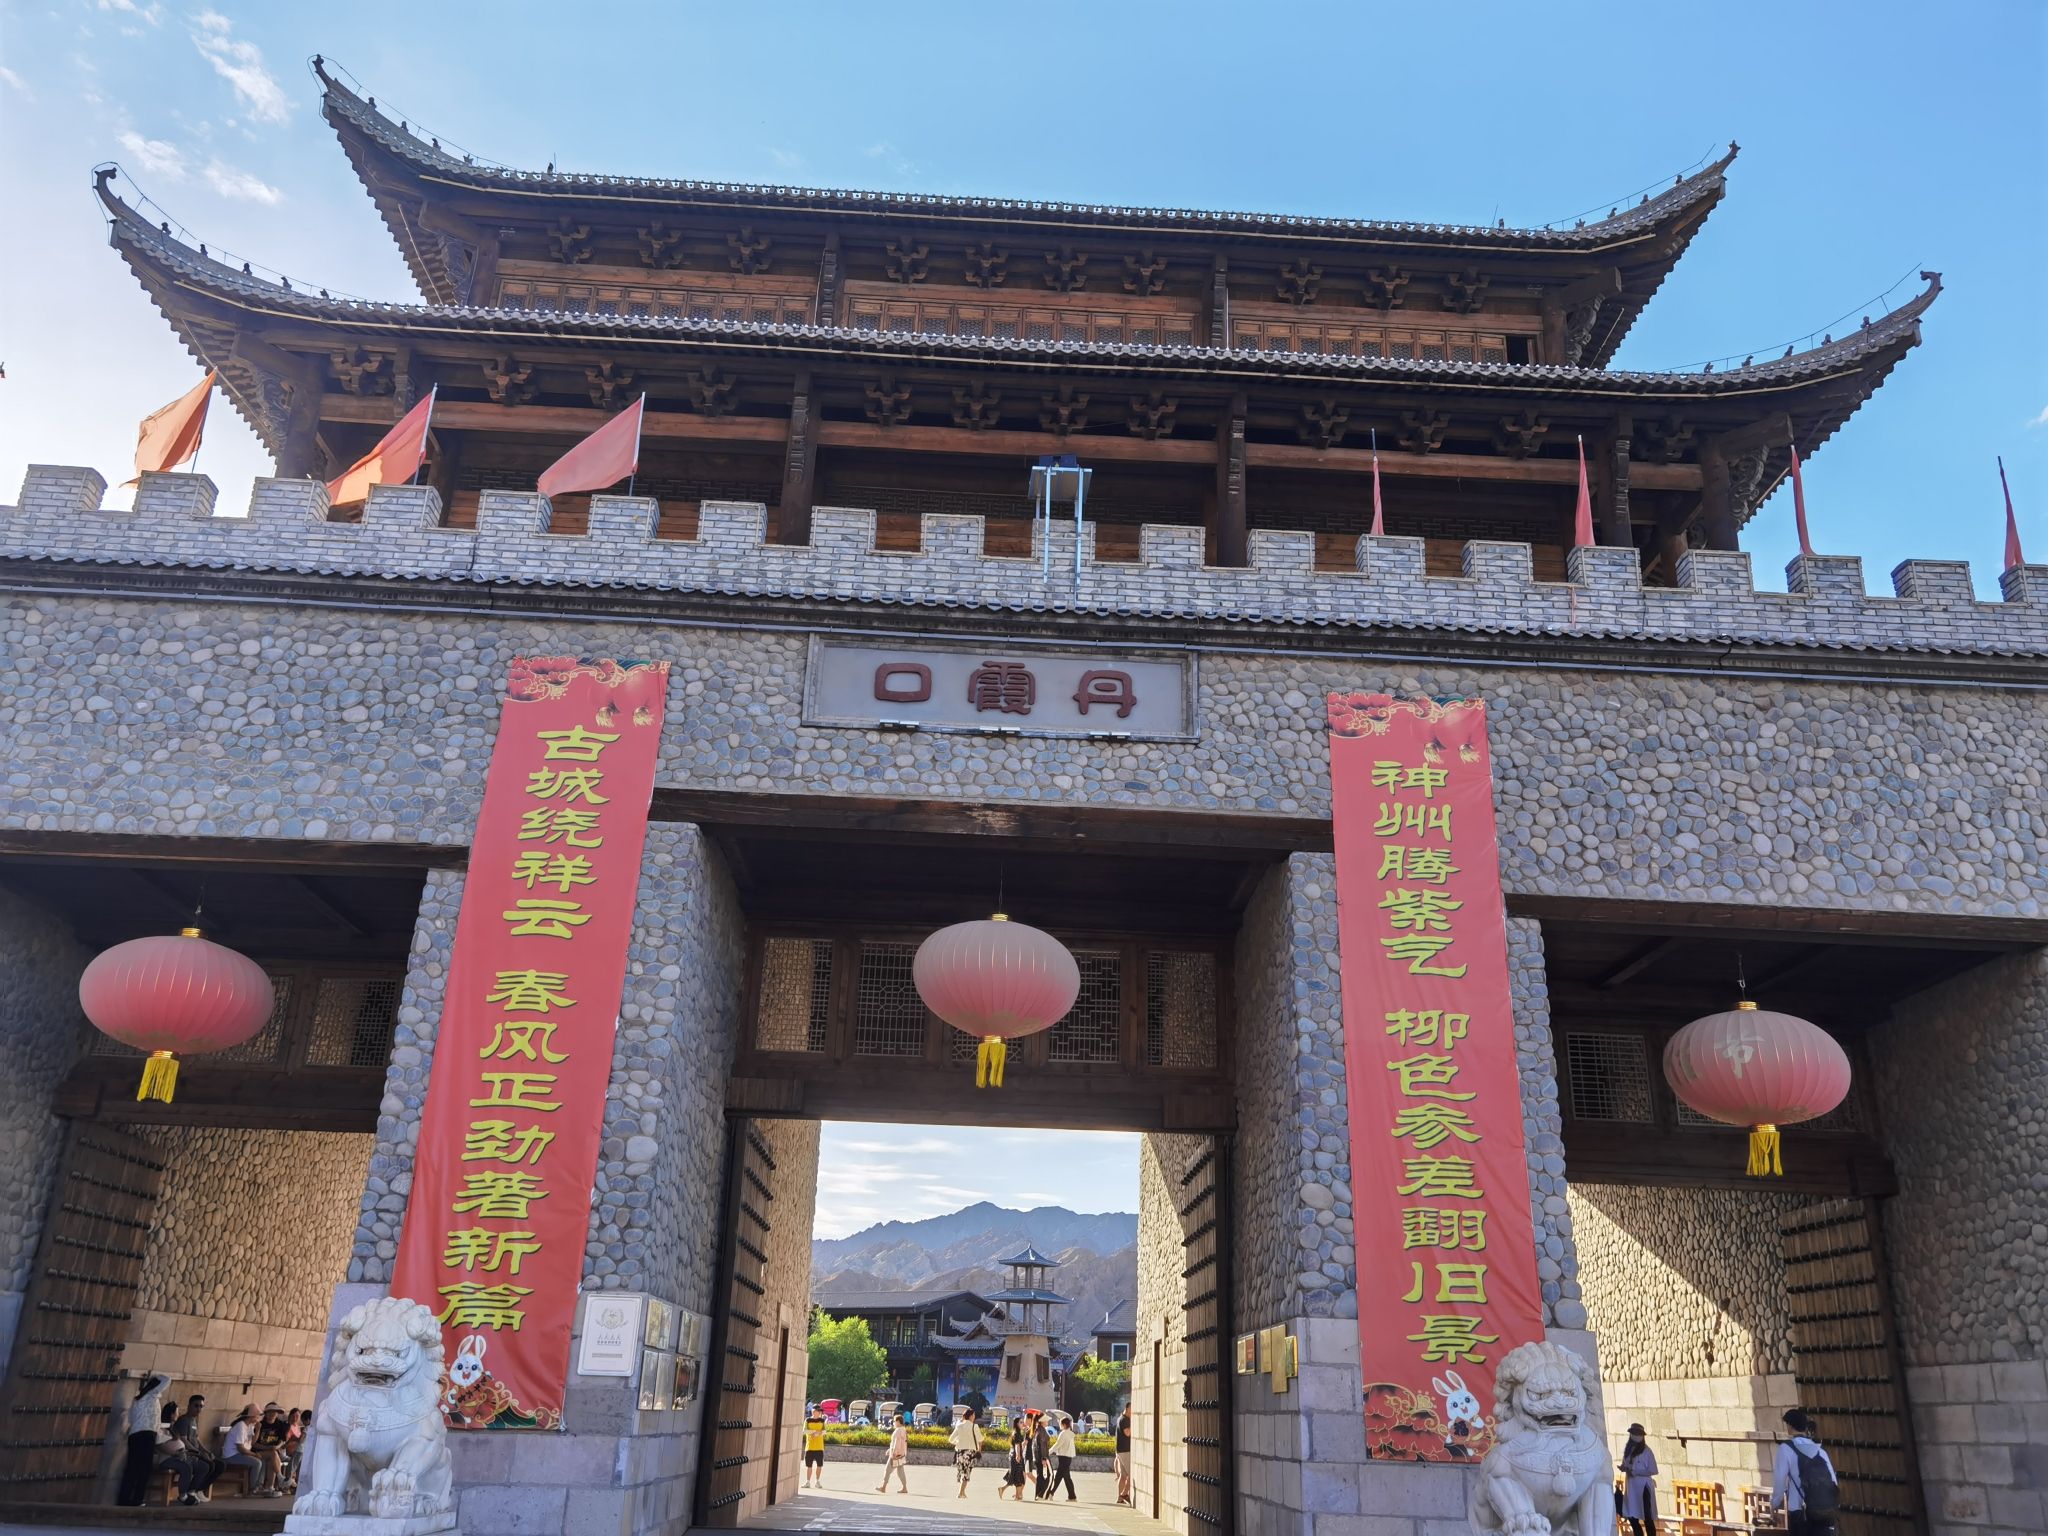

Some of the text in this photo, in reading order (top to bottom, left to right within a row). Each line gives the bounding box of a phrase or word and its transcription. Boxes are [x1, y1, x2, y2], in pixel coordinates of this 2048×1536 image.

[436, 724, 622, 1332] 古城绕祥云 春风正劲著新篇
[1370, 760, 1500, 1365] 神州腾紫气 柳色参差翻旧景
